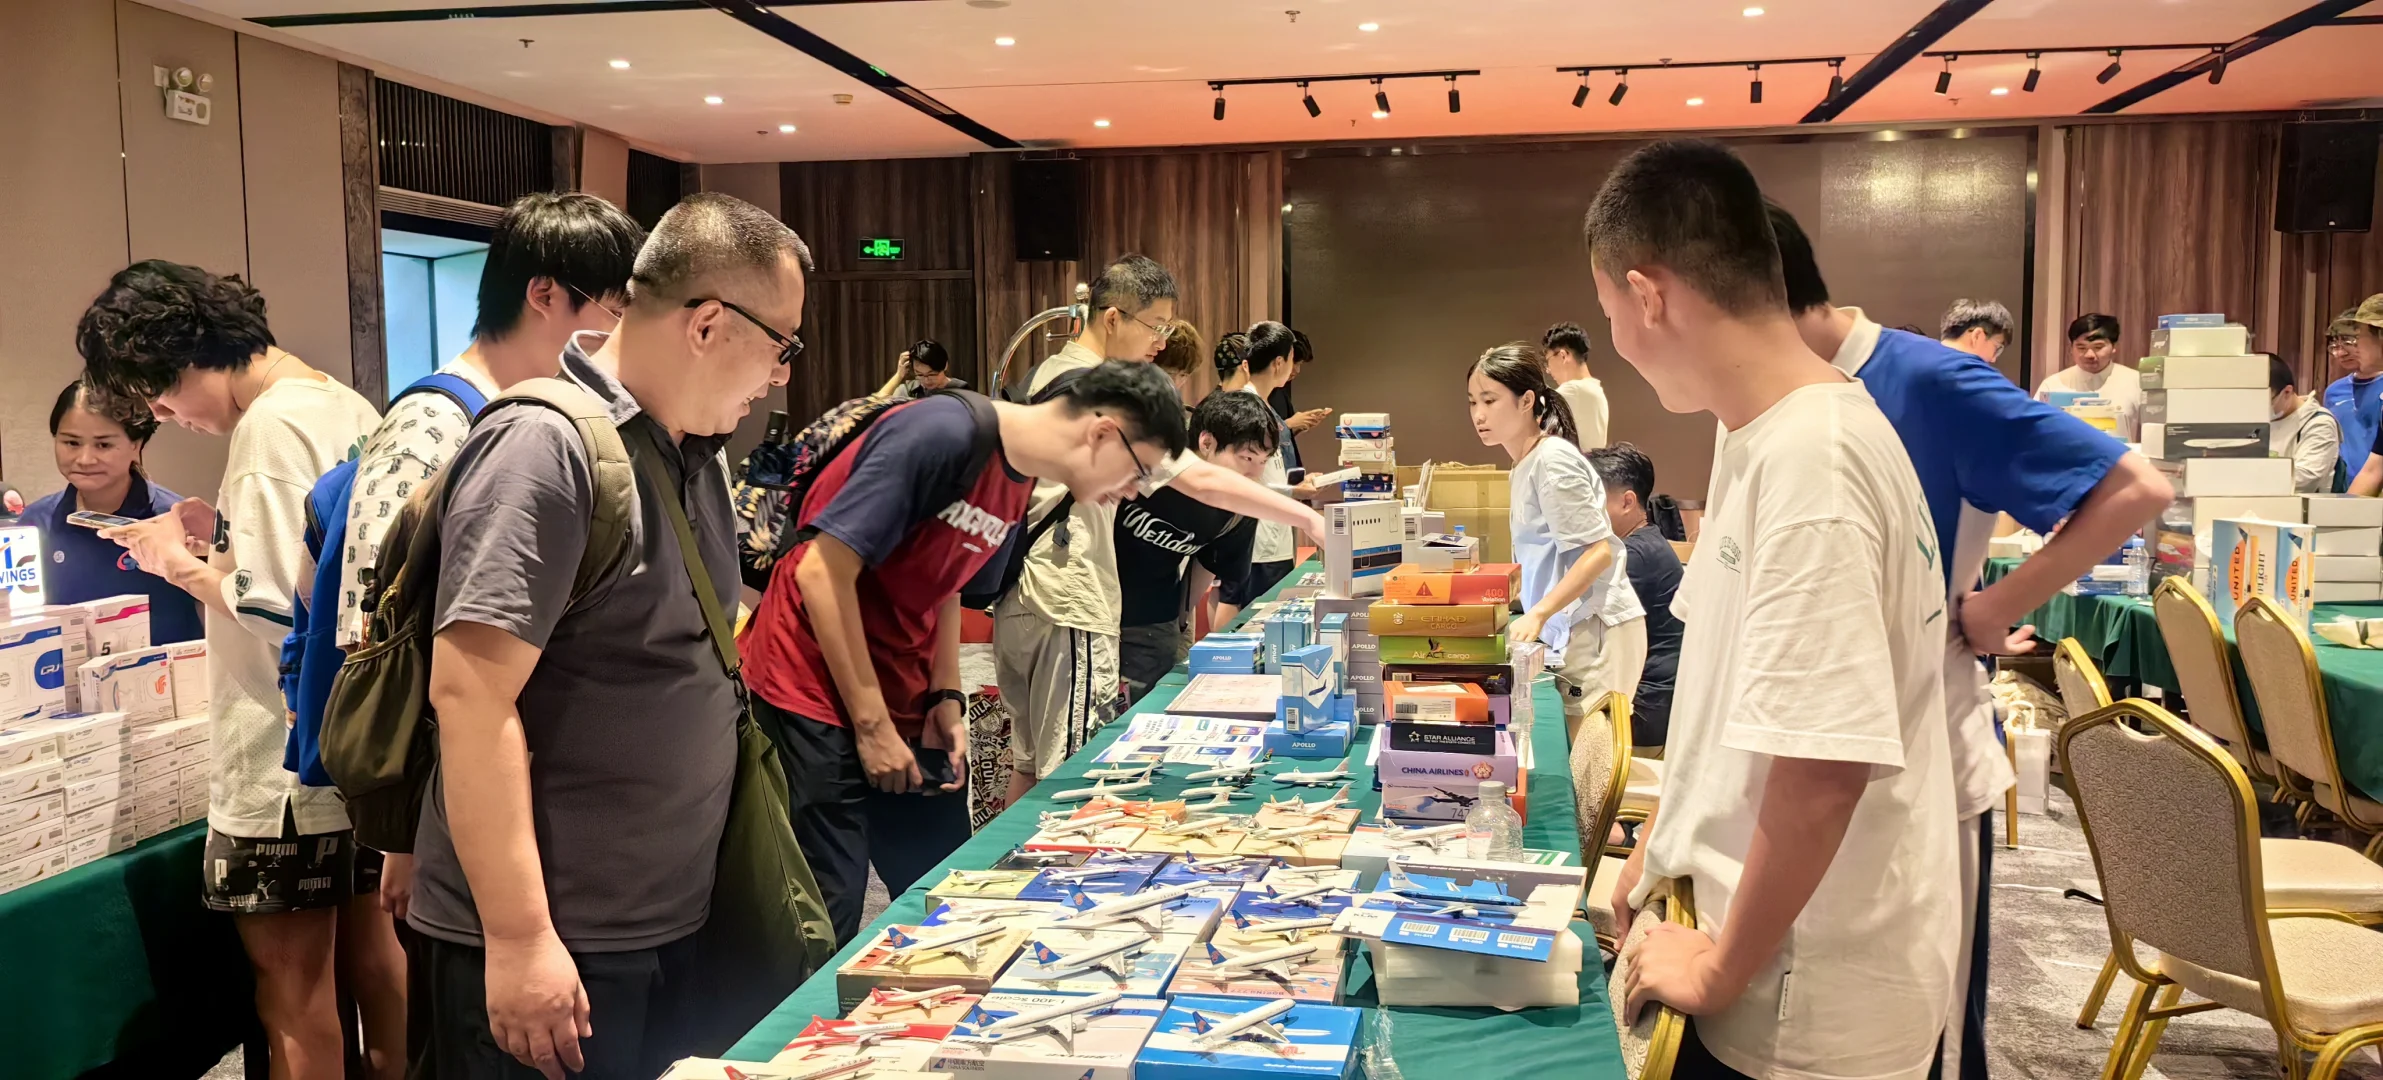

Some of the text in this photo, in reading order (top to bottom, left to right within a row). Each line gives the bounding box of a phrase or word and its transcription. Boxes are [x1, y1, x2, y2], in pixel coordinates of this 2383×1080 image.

[2233, 546, 2241, 600] UNITED
[2290, 560, 2298, 601] UNITED
[1485, 588, 1504, 598] 400
[1447, 653, 1470, 661] cargo
[1401, 766, 1464, 776] CHINA AIRLINES
[1451, 807, 1470, 820] 747
